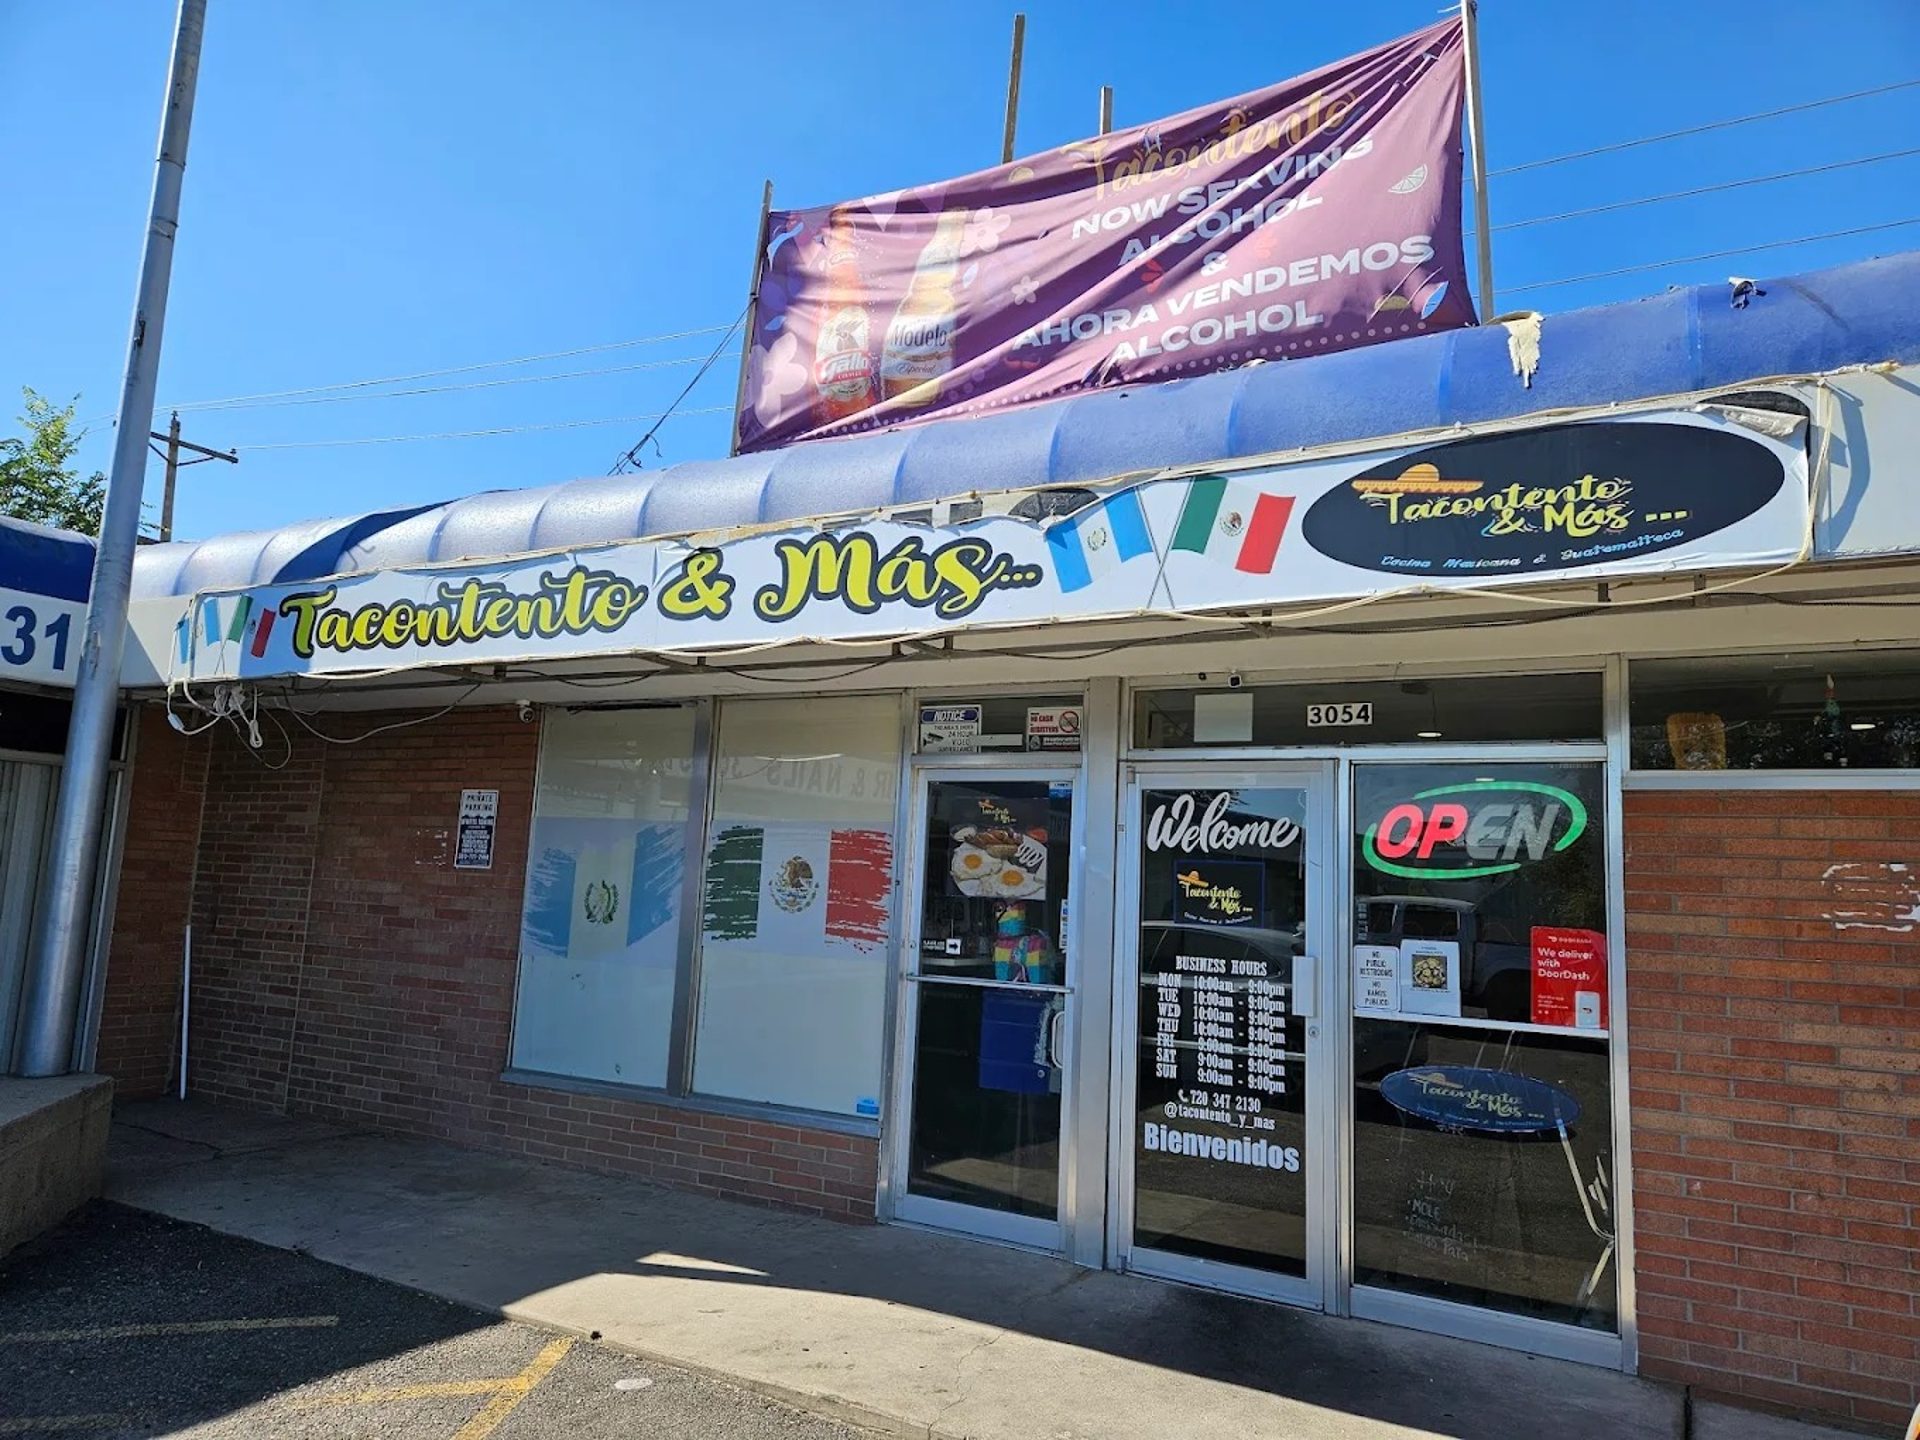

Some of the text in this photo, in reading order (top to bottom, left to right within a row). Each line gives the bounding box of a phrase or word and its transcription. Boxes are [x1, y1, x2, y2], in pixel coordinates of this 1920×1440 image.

[1060, 90, 1357, 199] Tacontento
[1071, 134, 1375, 240] NOW SERVING
[1118, 191, 1323, 267] ALCOHOL
[1200, 250, 1229, 277] &
[1011, 234, 1436, 351] AHORA VENDEMOS
[1112, 300, 1325, 361] ALCOHOL
[1359, 474, 1632, 524] Tacontento
[1490, 508, 1526, 536] &
[1543, 502, 1632, 537] Más
[1381, 528, 1685, 569] Cocina Mexicana & Guatemalteca
[280, 563, 647, 658] Tacontento
[660, 547, 735, 619] &
[1, 605, 71, 671] 31
[933, 709, 967, 721] NOTICE
[1309, 704, 1371, 724] 3054
[1146, 792, 1299, 853] Welcome
[1375, 803, 1560, 860] OPEN
[1178, 881, 1241, 898] Tacontento
[1175, 955, 1267, 976] BUSINESS HOURS
[1537, 947, 1594, 960] We deliver
[1537, 958, 1560, 968] with
[1158, 972, 1182, 988] MON
[1193, 975, 1234, 993] 10:00am
[1248, 979, 1285, 998] 9:00pm
[1537, 968, 1590, 981] DoorDash
[1157, 987, 1178, 1003] TUE
[1193, 991, 1234, 1008] 10:00am
[1248, 995, 1285, 1014] 9:00pm
[1157, 1002, 1181, 1018] WED
[1193, 1006, 1234, 1023] 10:00am
[1248, 1010, 1286, 1030] 9:00pm
[1157, 1017, 1179, 1033] THU
[1193, 1021, 1234, 1039] 10:00am
[1248, 1026, 1286, 1046] 9:00pm
[1156, 1032, 1175, 1047] FRI
[1198, 1037, 1234, 1054] 9:00am
[1248, 1042, 1286, 1062] 9:00pm
[1156, 1048, 1177, 1063] SAT
[1248, 1058, 1286, 1078] 9:00pm
[1156, 1064, 1178, 1079] SUN
[1198, 1068, 1233, 1086] 9:00am
[1248, 1075, 1286, 1094] 9:00pm
[1409, 1078, 1522, 1104] Tacontento
[1164, 1102, 1276, 1130] @tacontento_y_mas
[1190, 1090, 1261, 1113] 720 347 2130
[1144, 1122, 1300, 1173] Bienvenidos
